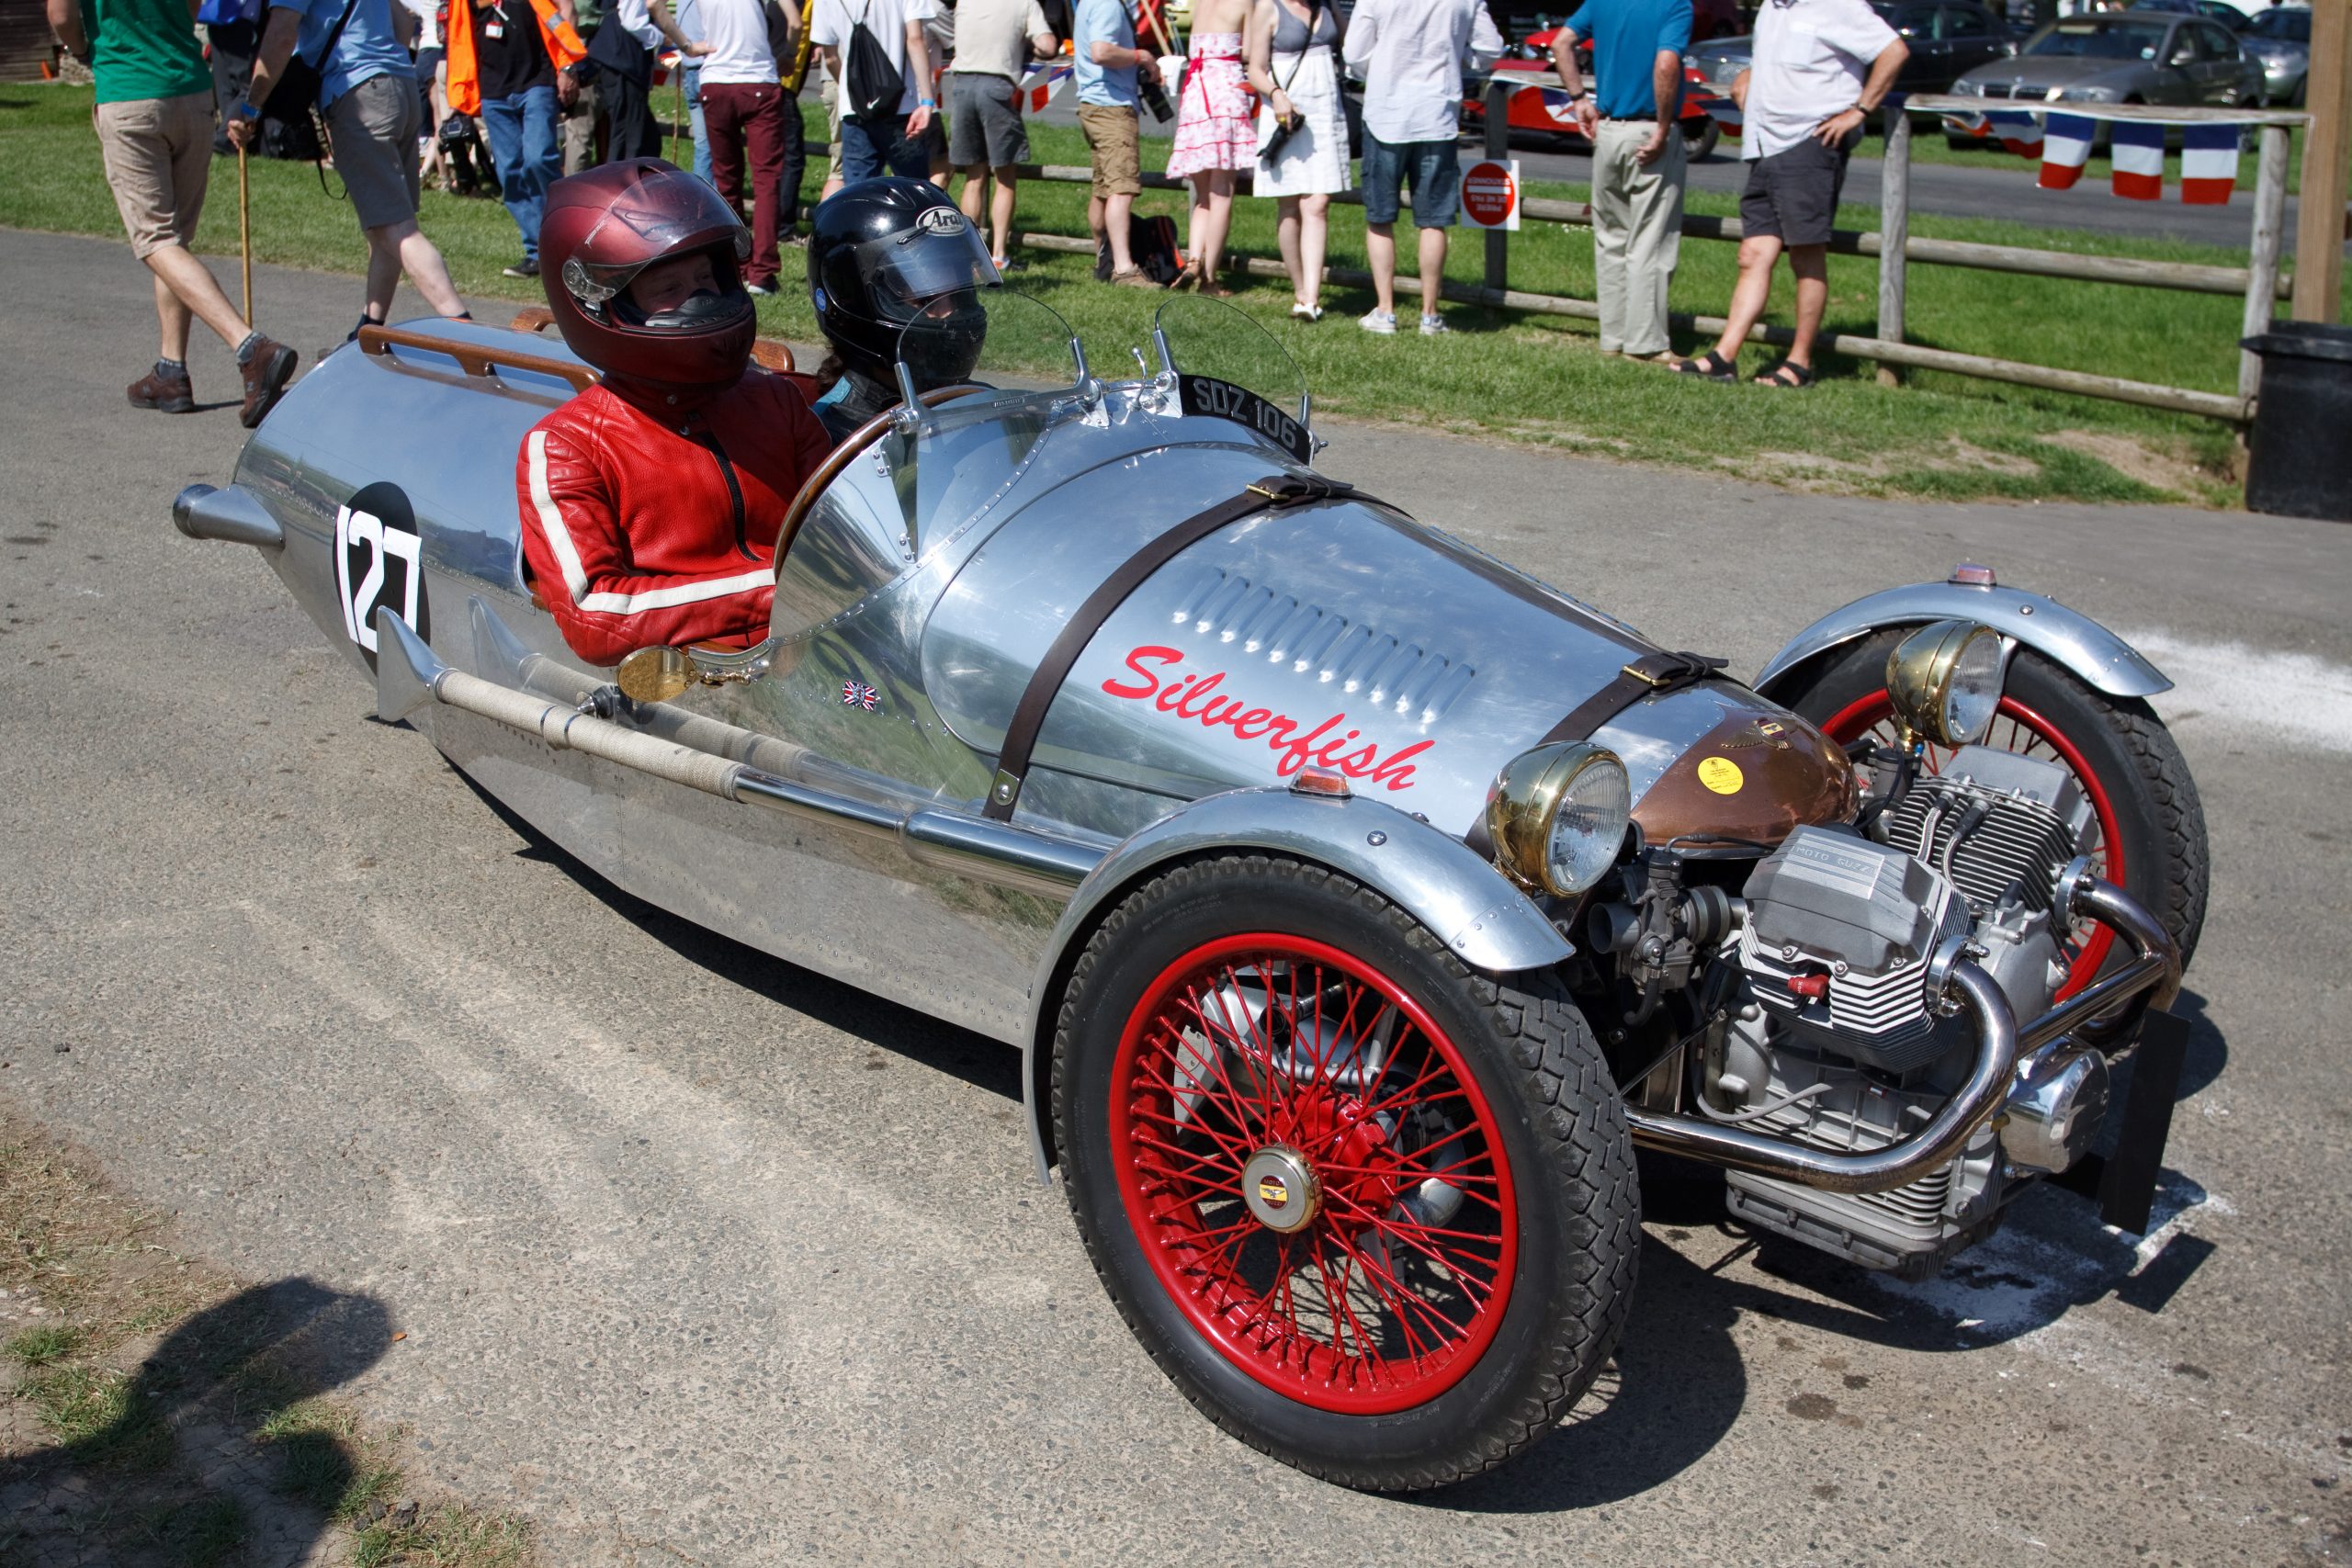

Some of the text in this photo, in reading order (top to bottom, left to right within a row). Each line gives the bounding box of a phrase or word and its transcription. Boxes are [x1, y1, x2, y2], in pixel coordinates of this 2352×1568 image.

[1193, 378, 1297, 449] SDZ 106
[336, 504, 423, 653] 127
[1102, 645, 1435, 791] Silverfish
[1796, 847, 1829, 861] MOTO
